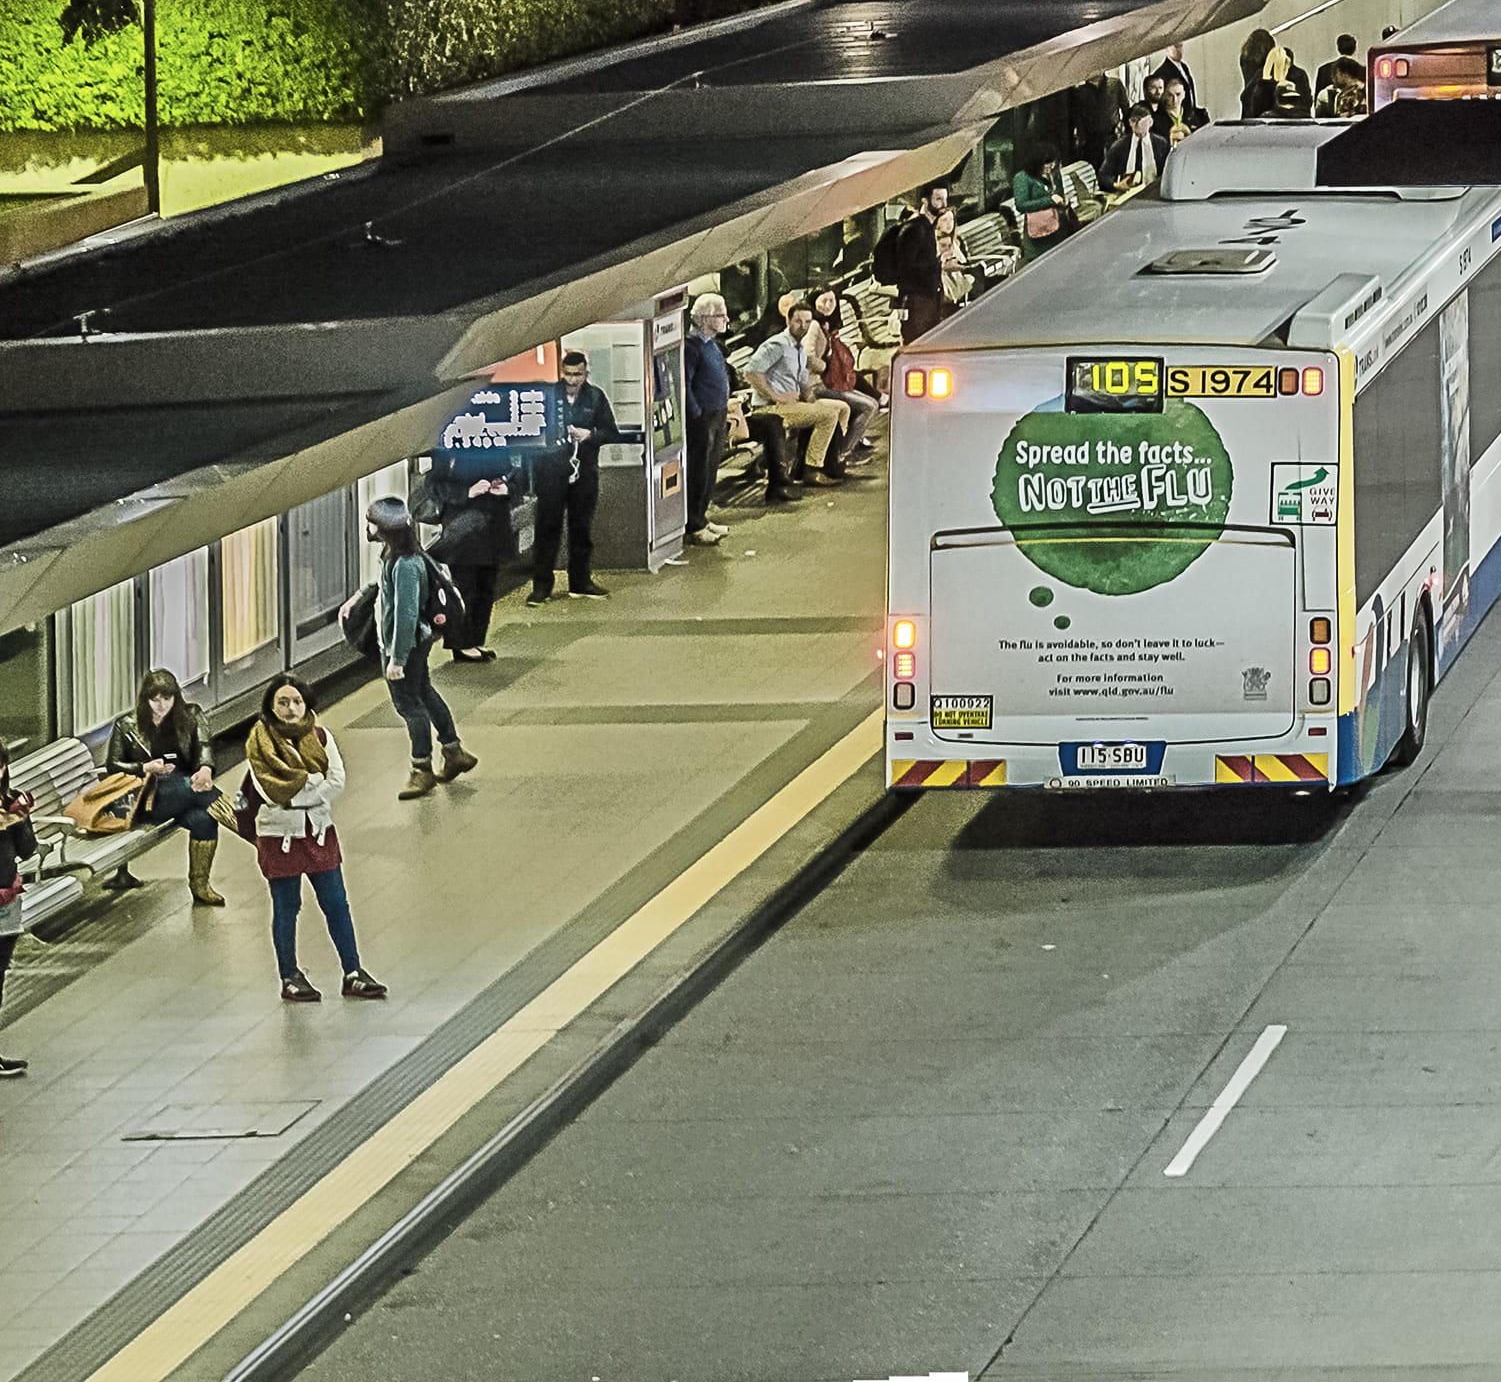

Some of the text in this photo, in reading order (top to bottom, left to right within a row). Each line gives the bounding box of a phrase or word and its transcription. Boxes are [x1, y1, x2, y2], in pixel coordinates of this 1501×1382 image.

[1091, 361, 1275, 395] 105 S 1974
[1016, 441, 1212, 468] Spread the facts...
[1018, 465, 1213, 513] NOT THE FLU
[1310, 496, 1336, 506] WAY
[999, 640, 1018, 650] The
[1019, 639, 1033, 649] flu
[1035, 639, 1044, 649] is
[1046, 639, 1099, 651] avoidable,
[1143, 638, 1170, 648] leave
[1172, 638, 1179, 648] it
[1181, 639, 1192, 648] to
[1038, 651, 1185, 664] act on the facts and stay well.
[1056, 673, 1164, 683] For more information
[1049, 686, 1174, 698] visit www.qld.gov.au/flu
